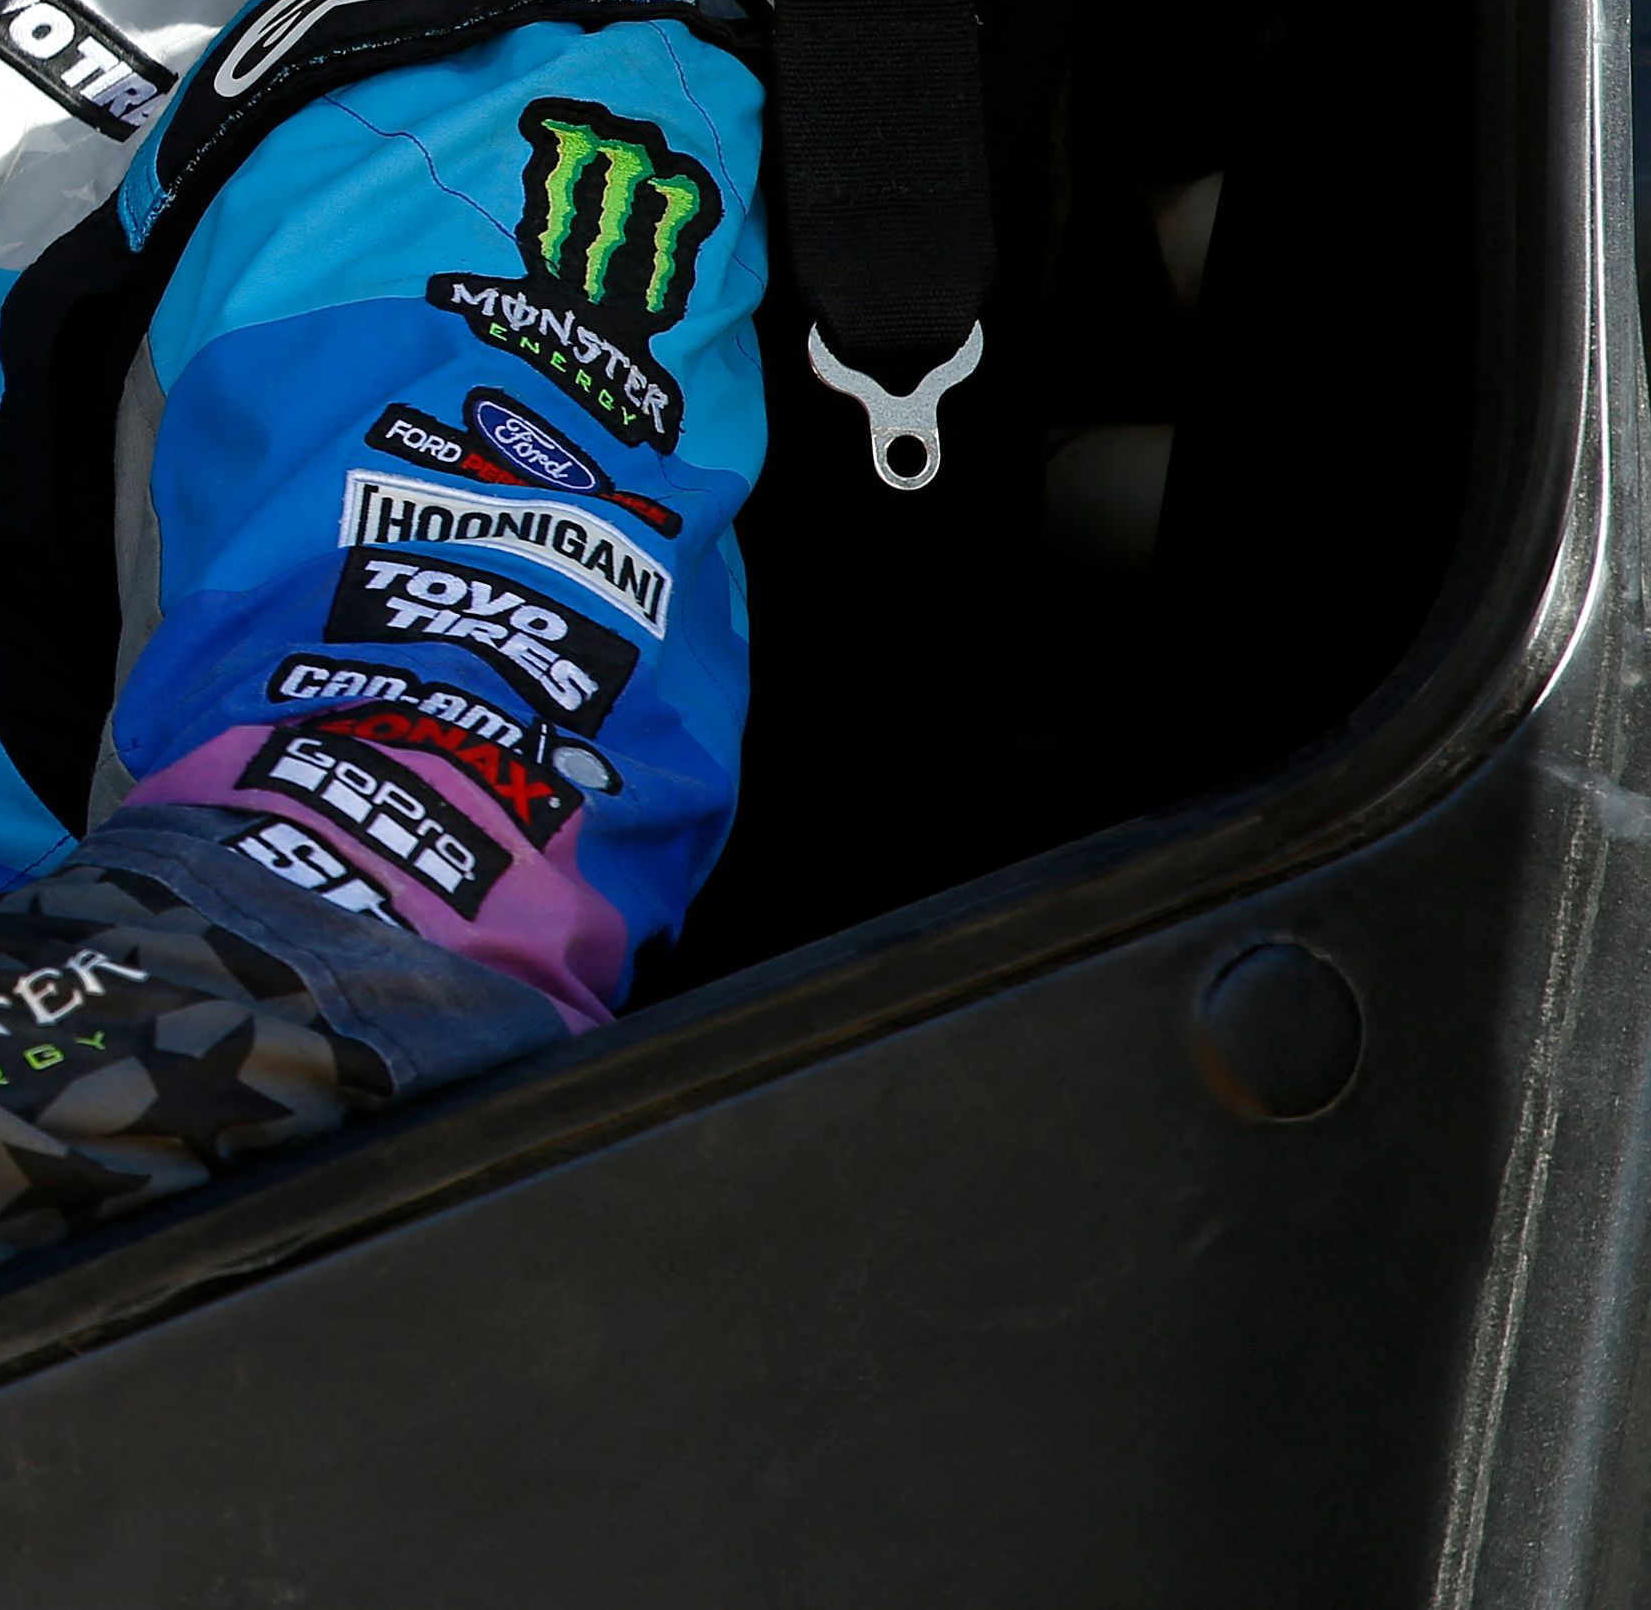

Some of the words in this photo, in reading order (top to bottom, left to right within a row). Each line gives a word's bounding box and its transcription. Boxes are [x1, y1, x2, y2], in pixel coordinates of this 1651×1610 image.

[450, 283, 669, 433] MONSTER
[489, 322, 637, 425] ENERGY
[385, 420, 463, 463] FORD
[494, 418, 570, 481] Ford
[364, 561, 568, 640] TOYO
[386, 597, 598, 712] TIRES
[286, 738, 477, 874] GoPro
